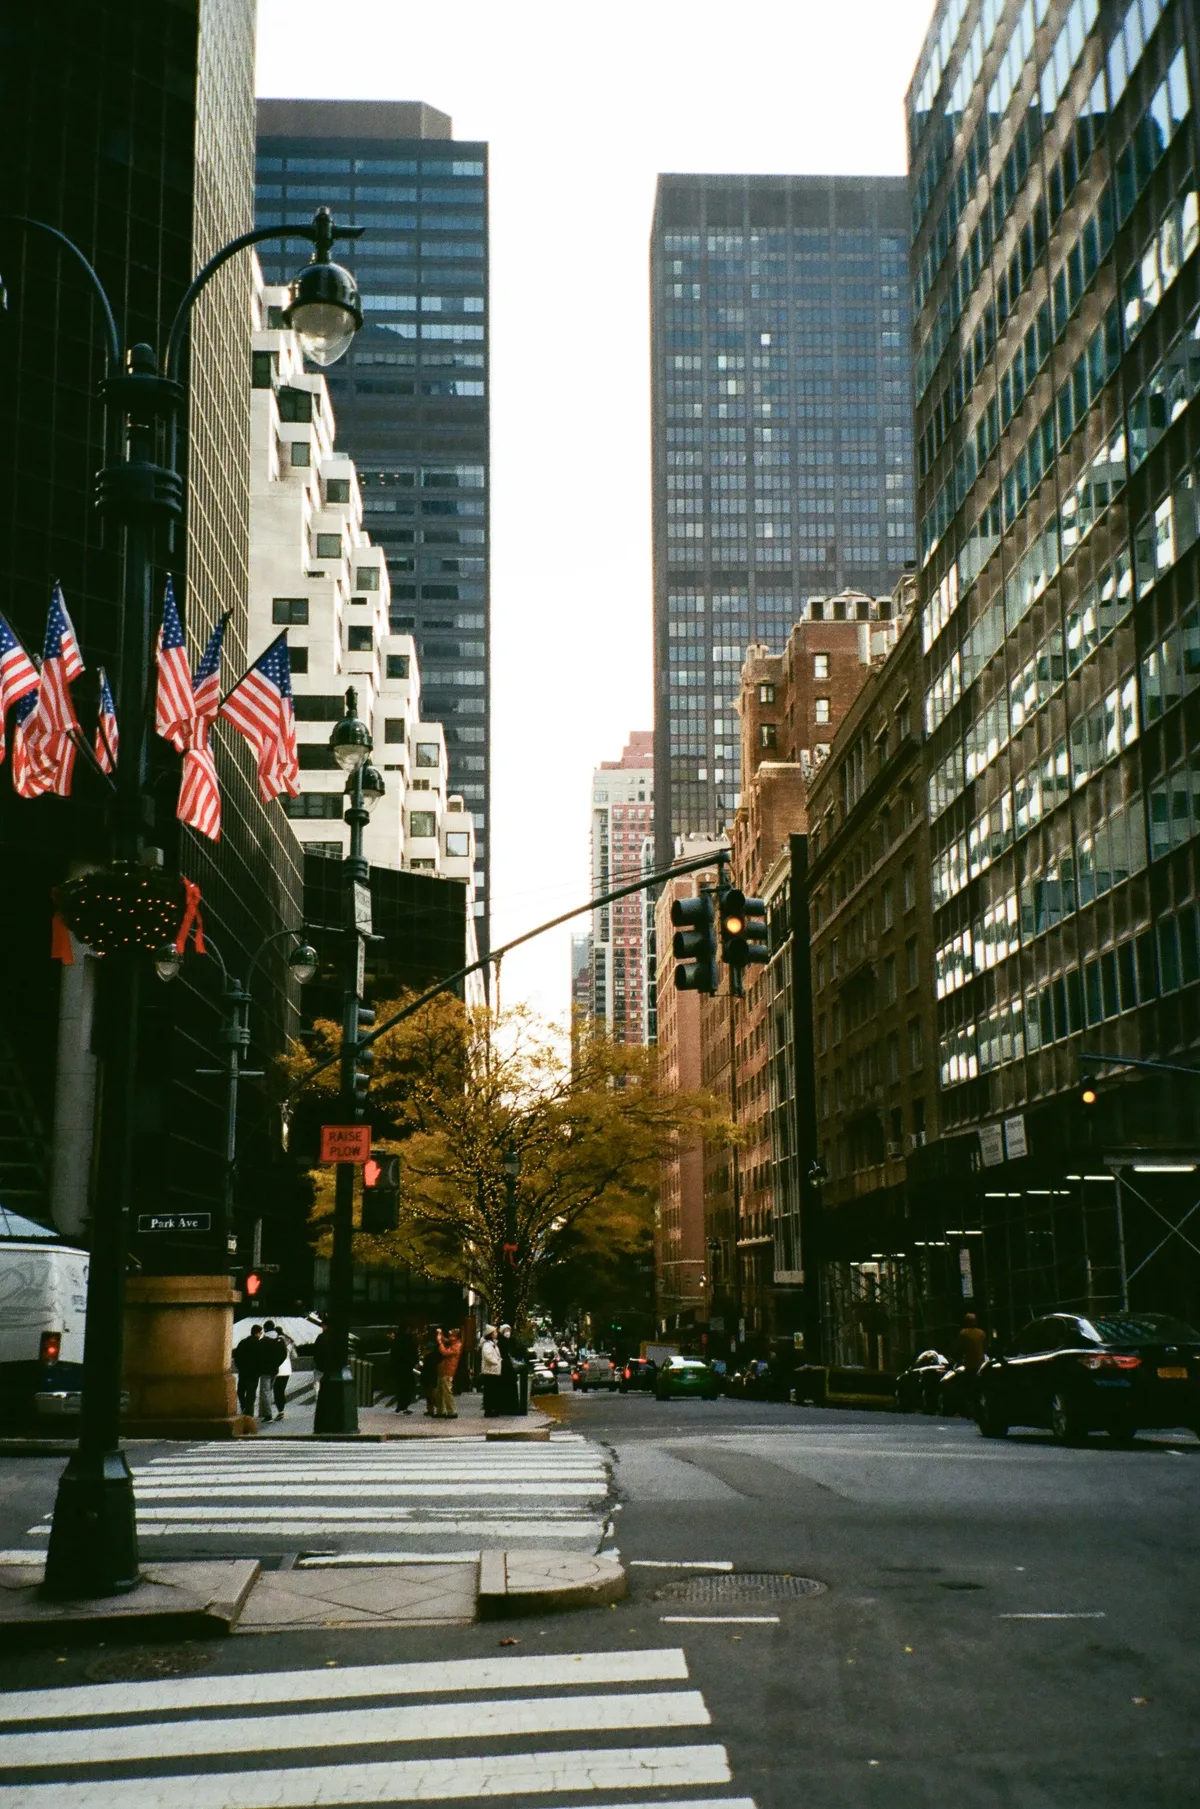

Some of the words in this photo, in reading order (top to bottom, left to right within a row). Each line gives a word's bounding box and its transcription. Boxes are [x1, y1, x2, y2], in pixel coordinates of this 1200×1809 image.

[328, 1131, 362, 1142] RAISE
[330, 1146, 361, 1157] PLOW
[150, 1218, 175, 1229] Park
[178, 1217, 199, 1228] Ave
